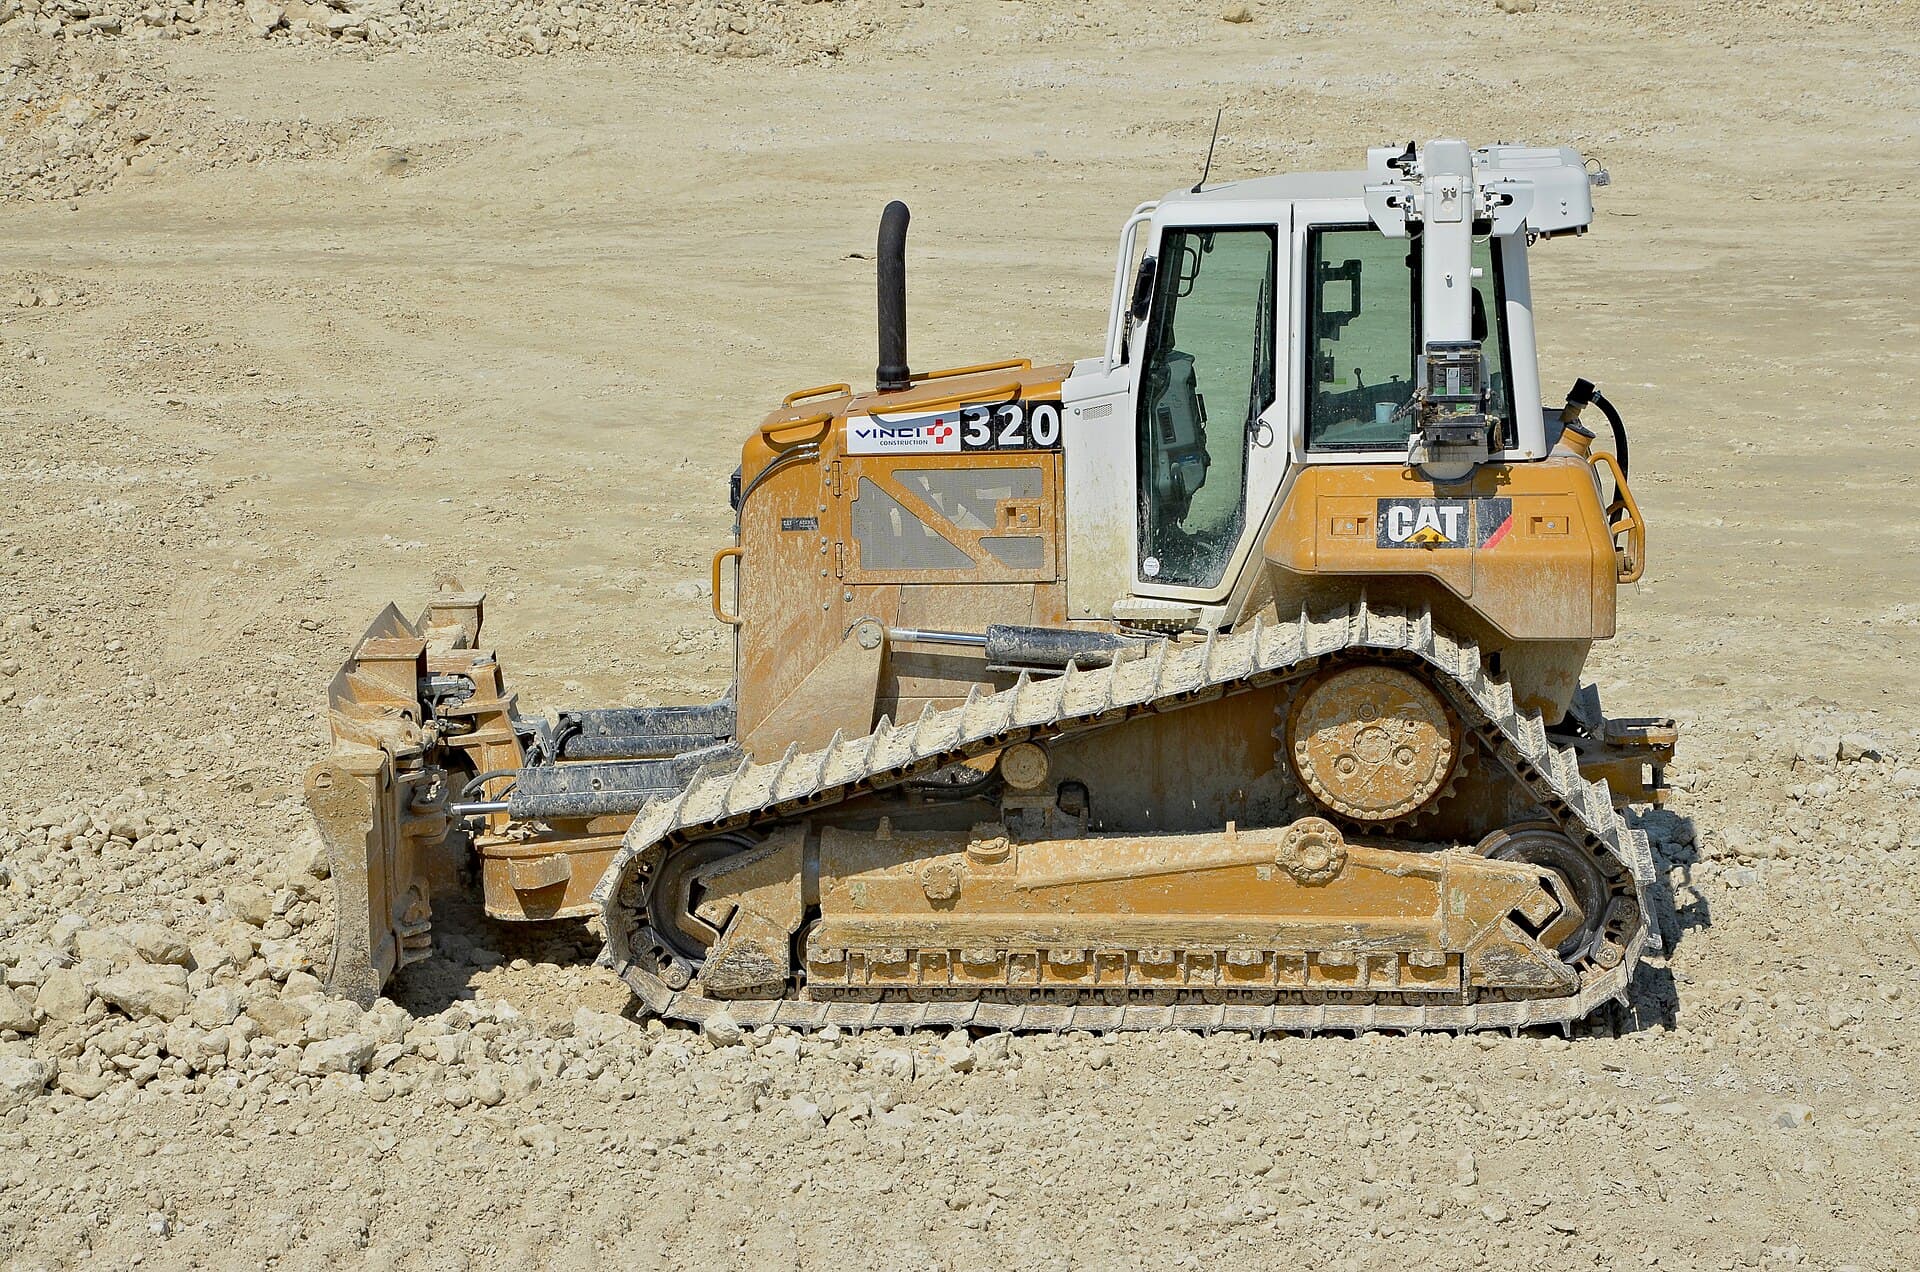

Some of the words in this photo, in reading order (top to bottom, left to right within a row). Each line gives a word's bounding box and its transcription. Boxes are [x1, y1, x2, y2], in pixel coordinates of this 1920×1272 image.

[855, 428, 920, 439] VINCI
[963, 404, 1060, 446] 320
[1387, 505, 1464, 543] CAT
